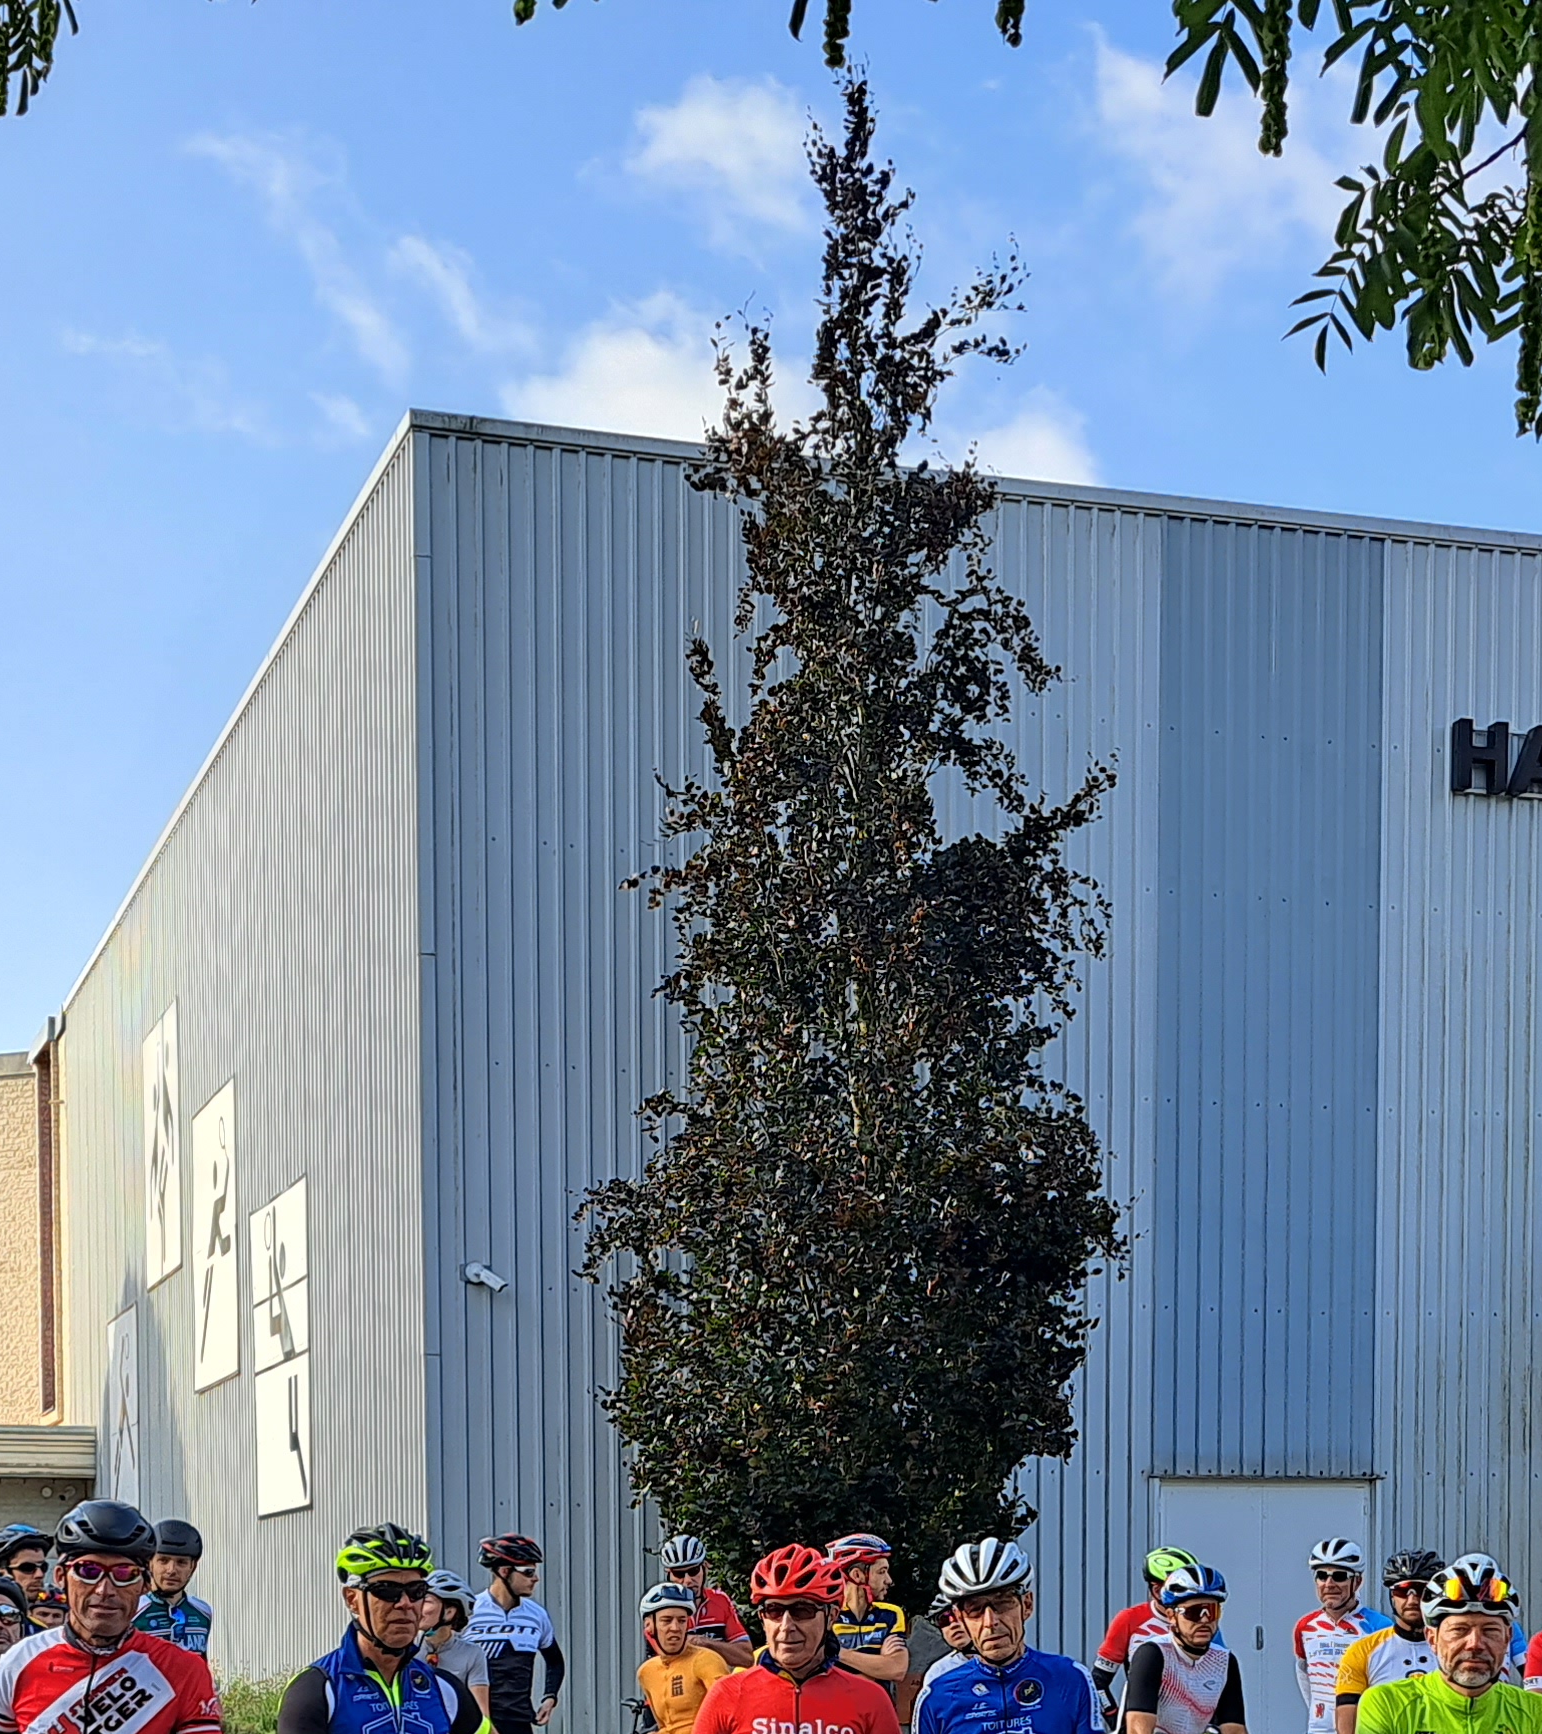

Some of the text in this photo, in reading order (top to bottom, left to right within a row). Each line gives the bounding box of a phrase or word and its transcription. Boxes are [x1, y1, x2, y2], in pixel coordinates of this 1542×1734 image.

[471, 1624, 539, 1636] SCOTT
[76, 1675, 137, 1727] VELO
[981, 1714, 1033, 1732] TOITURES
